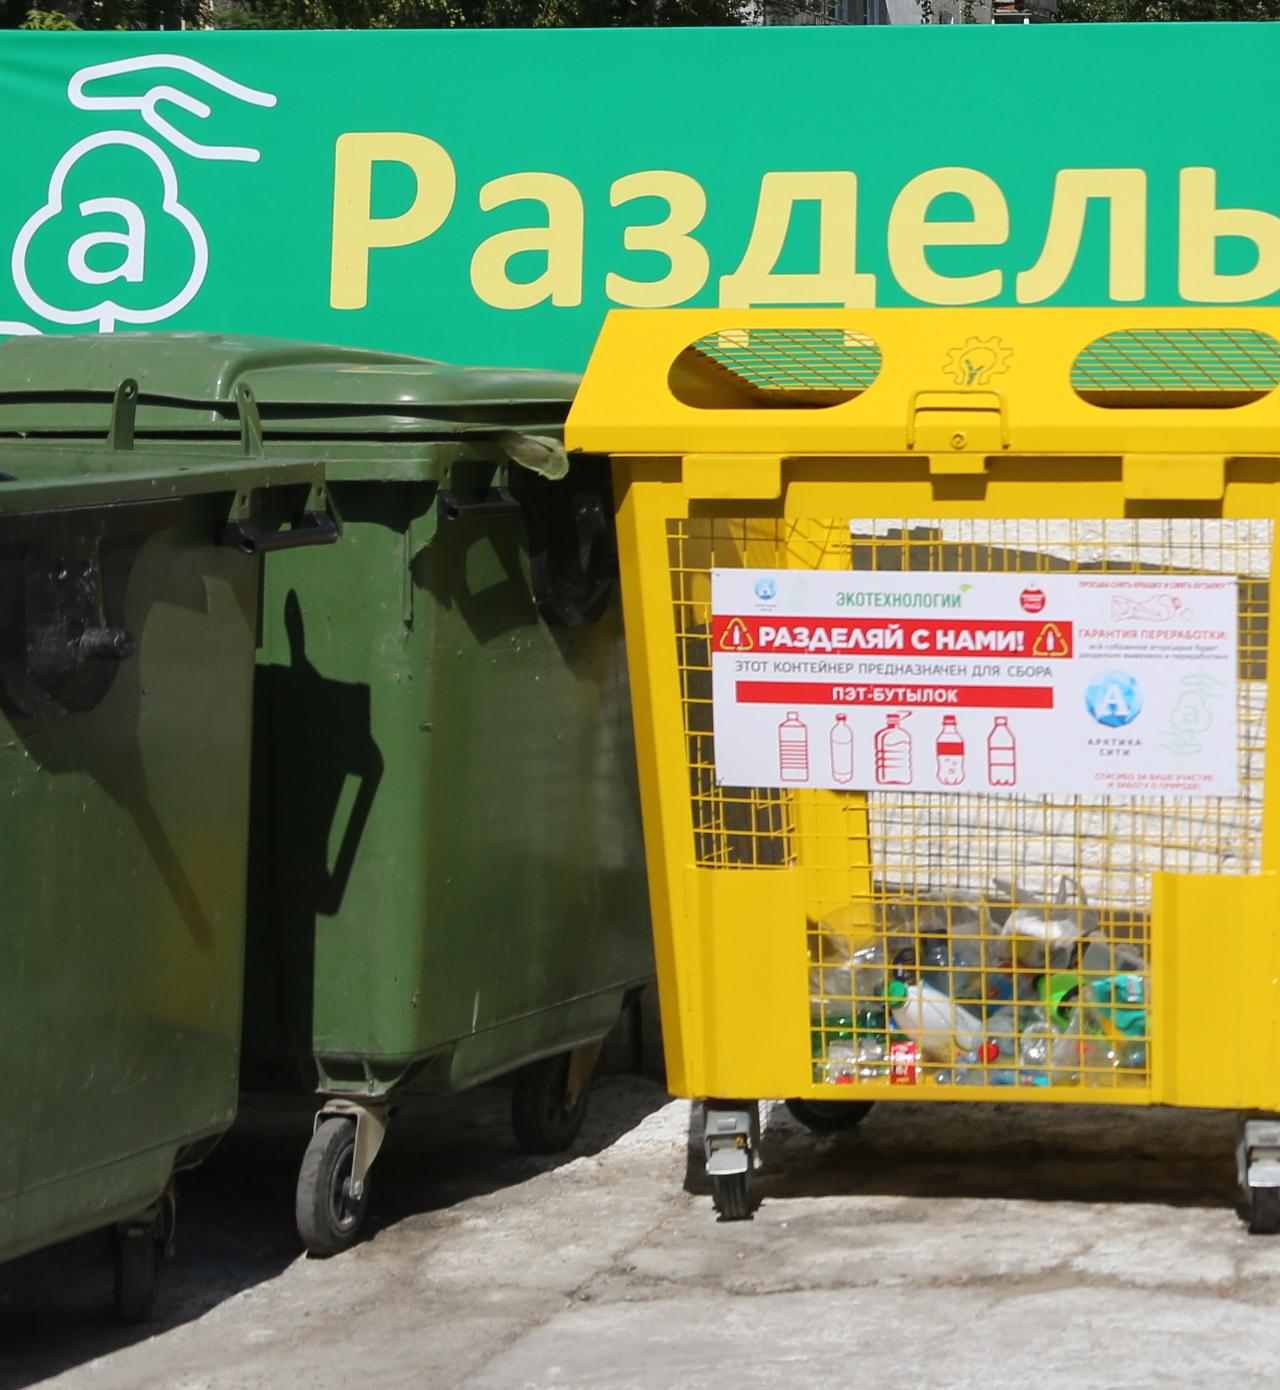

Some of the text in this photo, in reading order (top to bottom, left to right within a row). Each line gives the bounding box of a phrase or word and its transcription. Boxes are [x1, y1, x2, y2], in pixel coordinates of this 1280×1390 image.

[836, 591, 961, 608] ЭКОТЕХНОЛОГИИ
[758, 624, 1025, 652] РАЗДЕЛЯЙ С НАМИ!
[1079, 629, 1138, 639] ГАРАНТИЯ
[735, 660, 1052, 678] ЭТОТ КОНТЕЙНЕР ПРЕДНАЗНАЧЕН ДЛЯ СБОРА
[832, 686, 959, 703] ПЭТ-БУТЫЛОК
